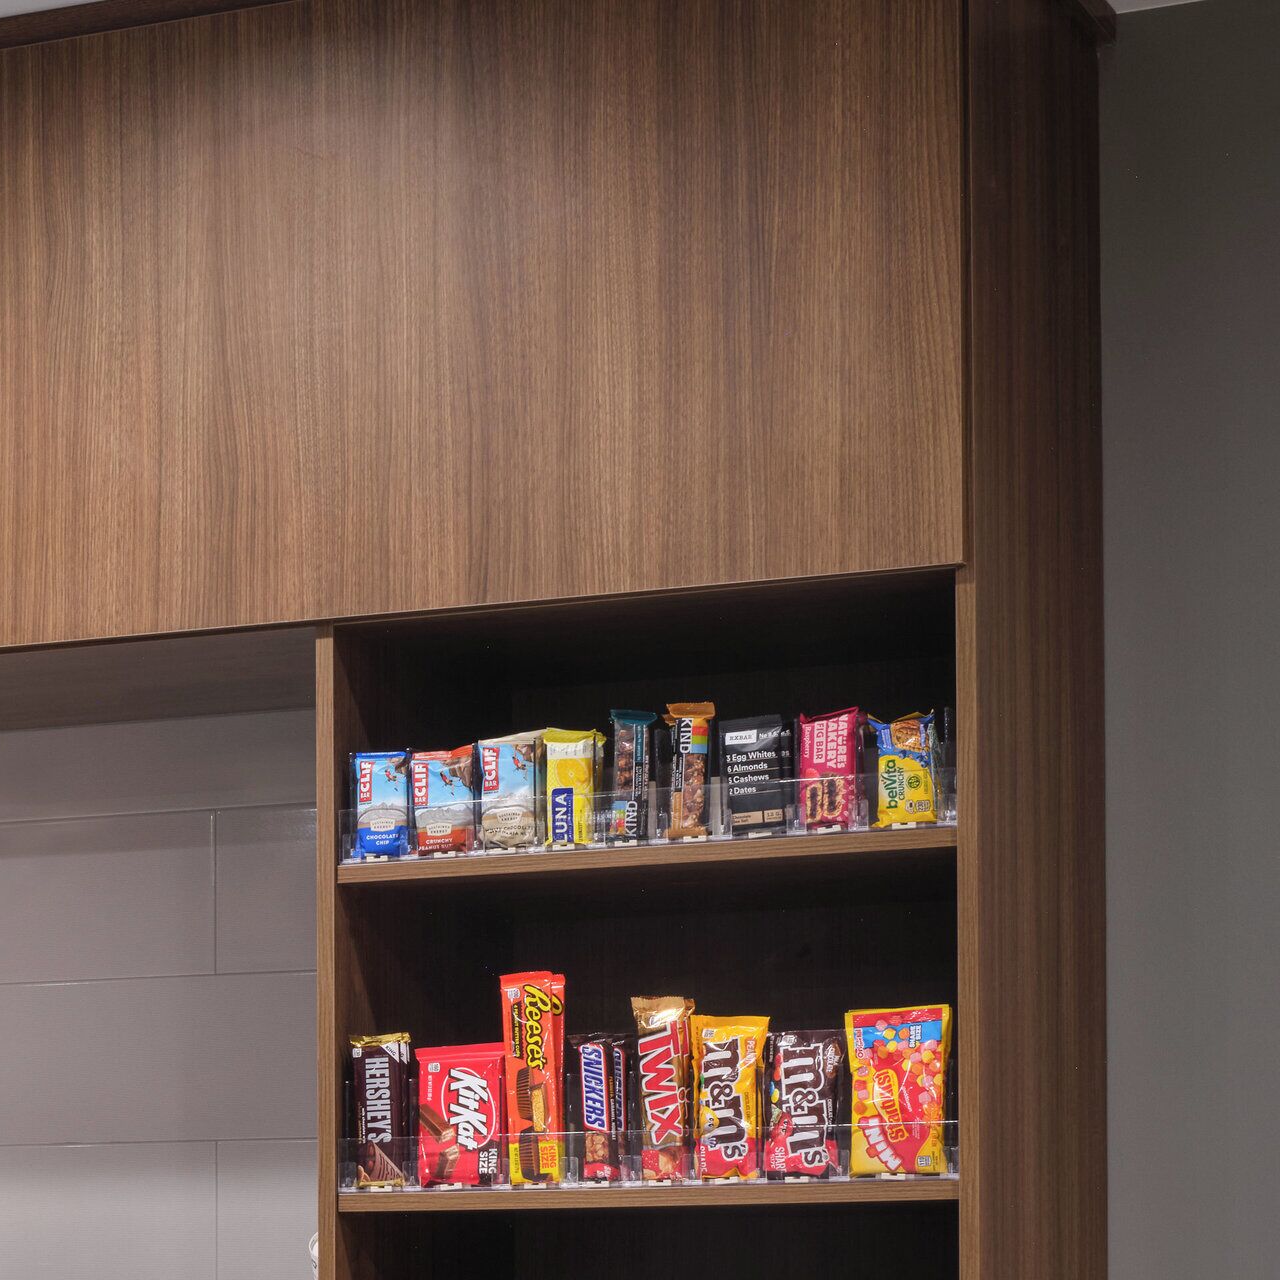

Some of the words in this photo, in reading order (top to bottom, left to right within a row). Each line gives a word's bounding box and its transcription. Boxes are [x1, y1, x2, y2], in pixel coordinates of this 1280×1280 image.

[679, 718, 693, 753] KIND
[814, 723, 825, 738] FIG
[483, 748, 498, 781] CLIF
[732, 753, 746, 762] Egg
[748, 751, 776, 759] Whites
[814, 740, 825, 763] BAR
[360, 761, 371, 792] CLIF
[414, 763, 428, 798] CLIF
[886, 759, 898, 810] belVita
[554, 793, 568, 842] LUNA
[624, 800, 638, 837] KIND
[580, 1044, 606, 1130] SNICKERS
[639, 1021, 681, 1145] TWIX
[365, 1057, 392, 1144] HERSHEY'S
[478, 1150, 488, 1174] SIZE
[488, 1148, 498, 1174] KING
[541, 1146, 549, 1168] SIZE
[548, 1145, 556, 1168] KING
